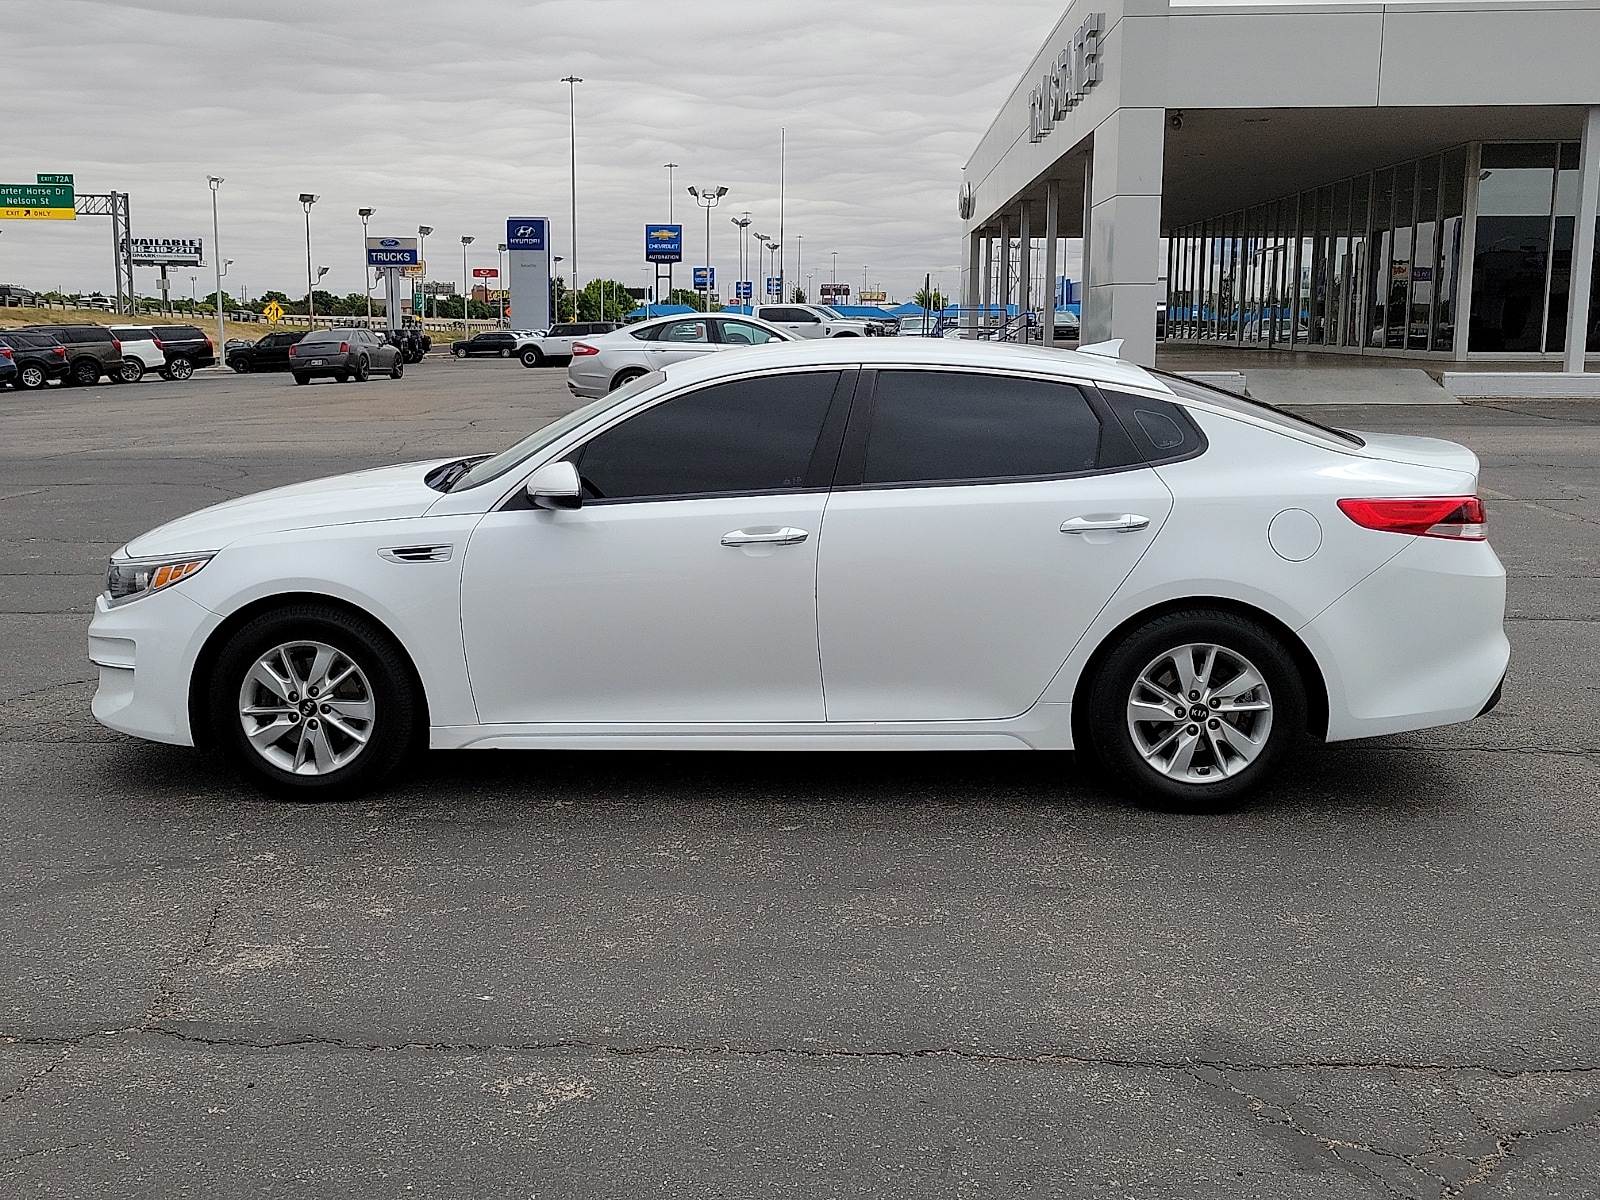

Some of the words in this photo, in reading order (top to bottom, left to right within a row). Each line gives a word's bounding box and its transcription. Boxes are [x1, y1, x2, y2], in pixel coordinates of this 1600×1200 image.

[55, 175, 70, 183] 72A
[0, 187, 22, 195] arter
[26, 187, 52, 195] Horse
[55, 187, 65, 195] Dr
[6, 197, 37, 205] Nelson
[40, 197, 50, 205] St
[510, 237, 541, 245] HYUNDAI
[371, 252, 411, 262] TRUCKS
[301, 701, 315, 716] KIA
[1191, 708, 1207, 718] KIA
